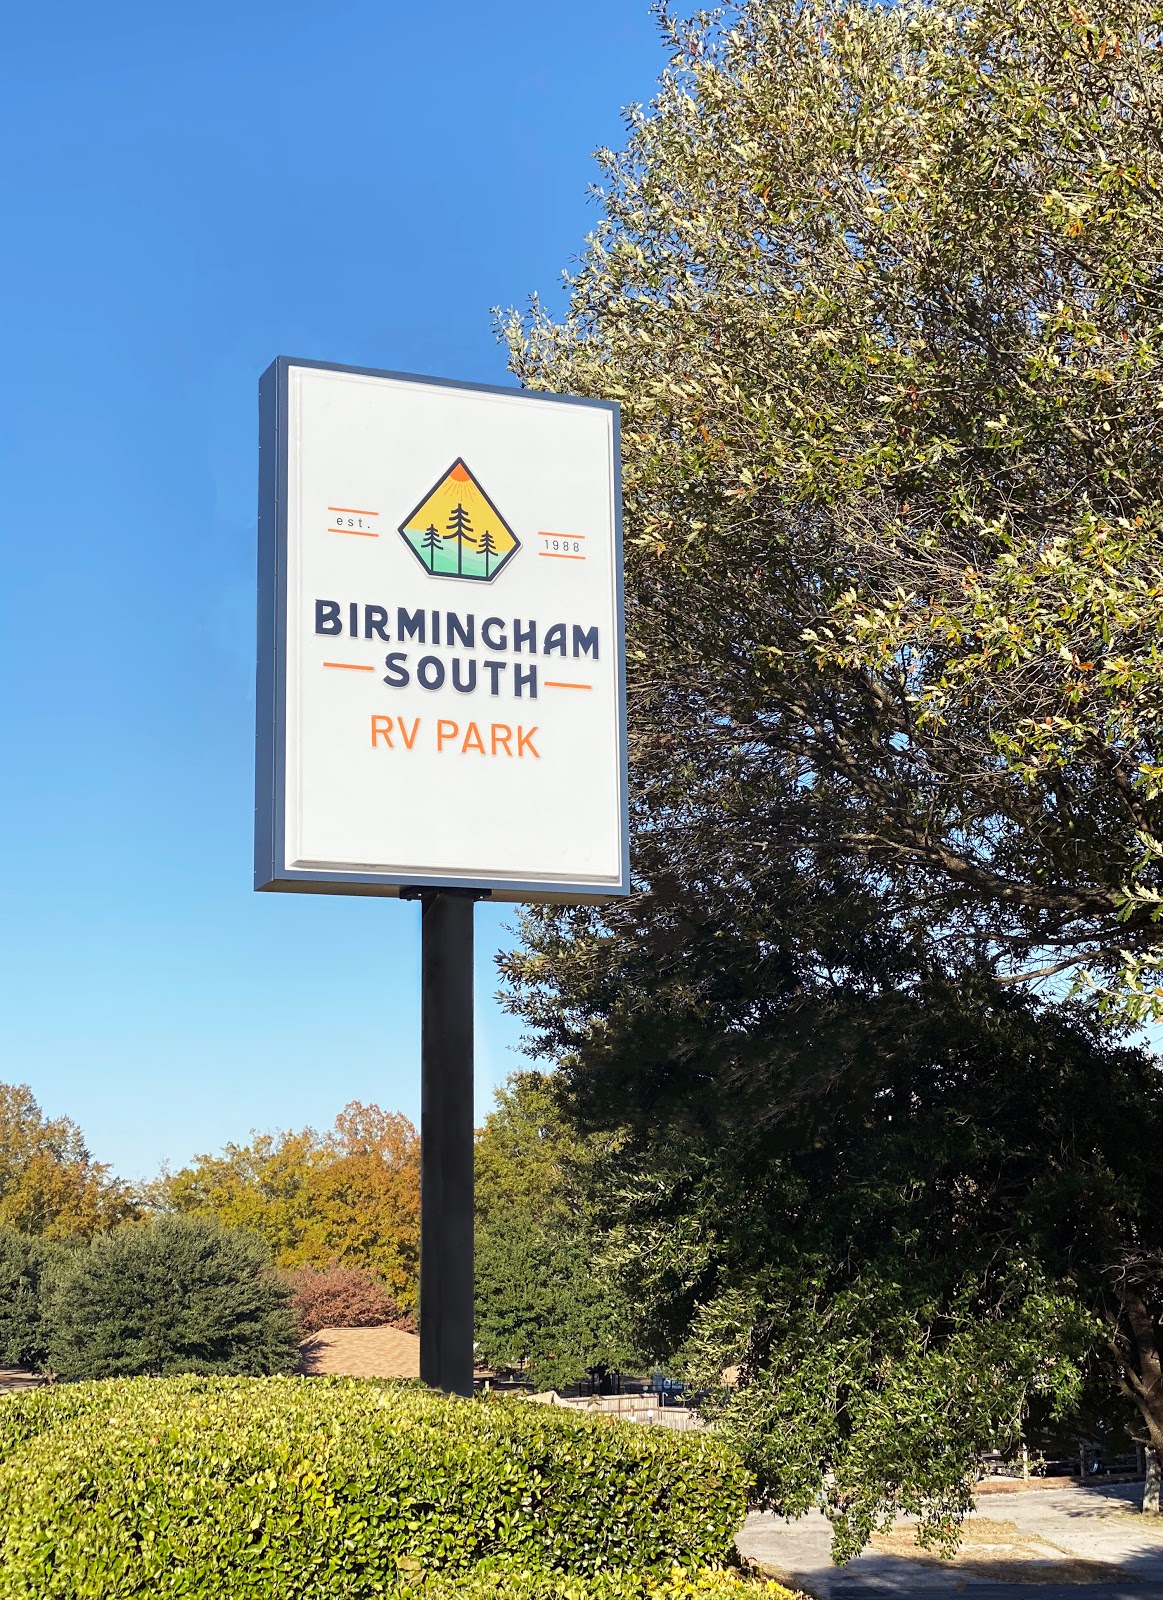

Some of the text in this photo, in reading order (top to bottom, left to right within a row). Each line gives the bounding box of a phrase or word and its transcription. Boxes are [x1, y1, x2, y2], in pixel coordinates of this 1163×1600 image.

[336, 515, 371, 529] est.
[544, 539, 580, 553] 1988
[314, 599, 600, 660] BIRMINGHAM
[383, 652, 539, 699] SOUTH
[371, 714, 541, 758] RV PARK
